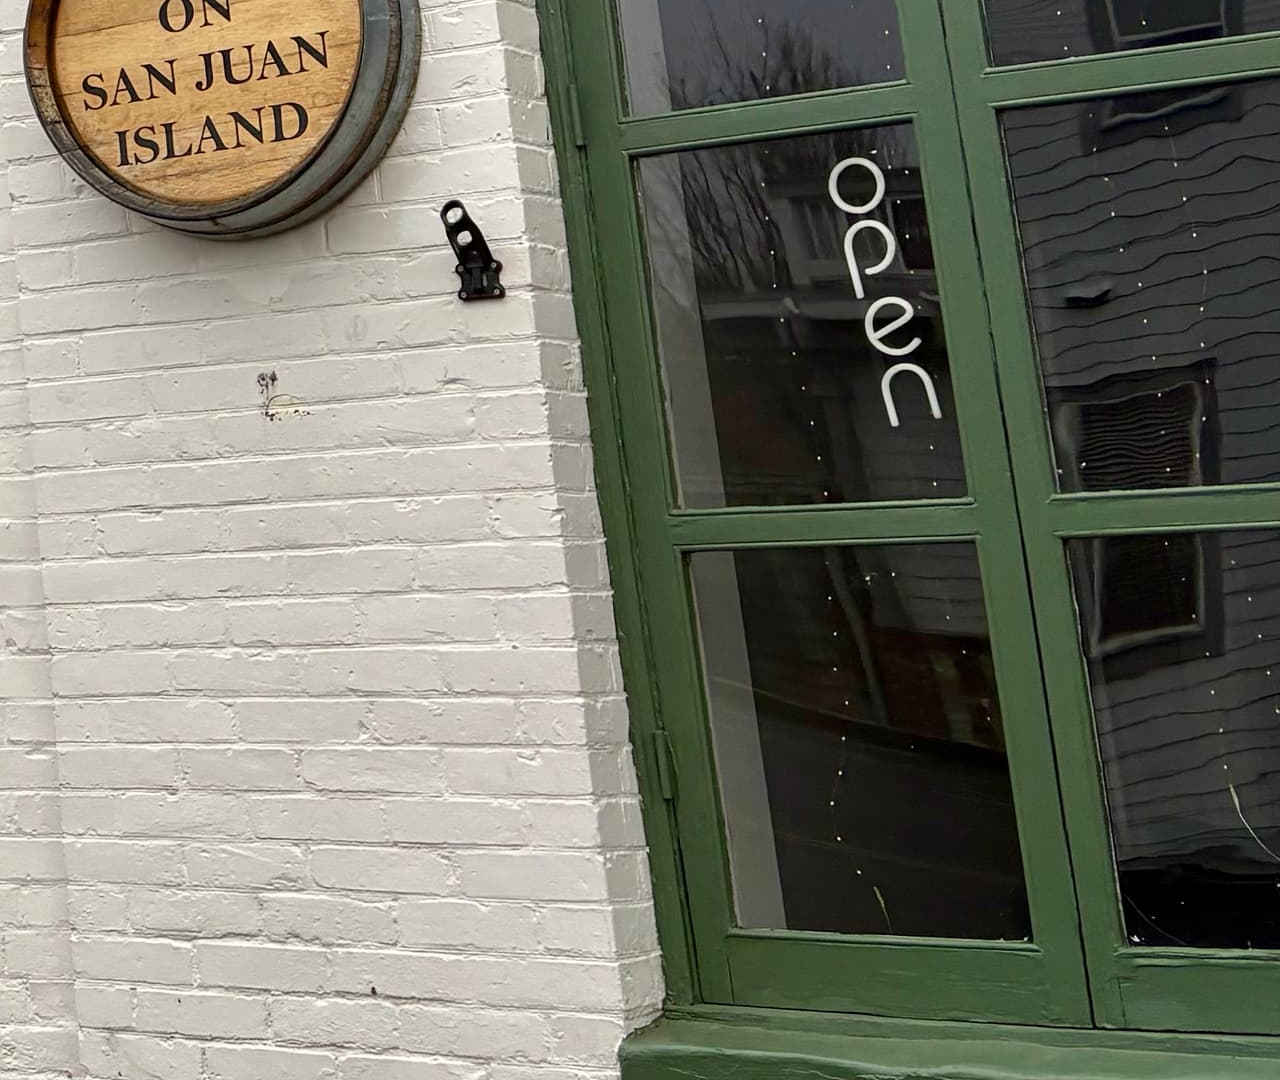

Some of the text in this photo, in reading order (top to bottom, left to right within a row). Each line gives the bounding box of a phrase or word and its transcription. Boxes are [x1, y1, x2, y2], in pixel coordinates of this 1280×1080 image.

[81, 30, 331, 112] SAN JUAN
[114, 101, 309, 168] ISLAND
[827, 156, 943, 428] open
